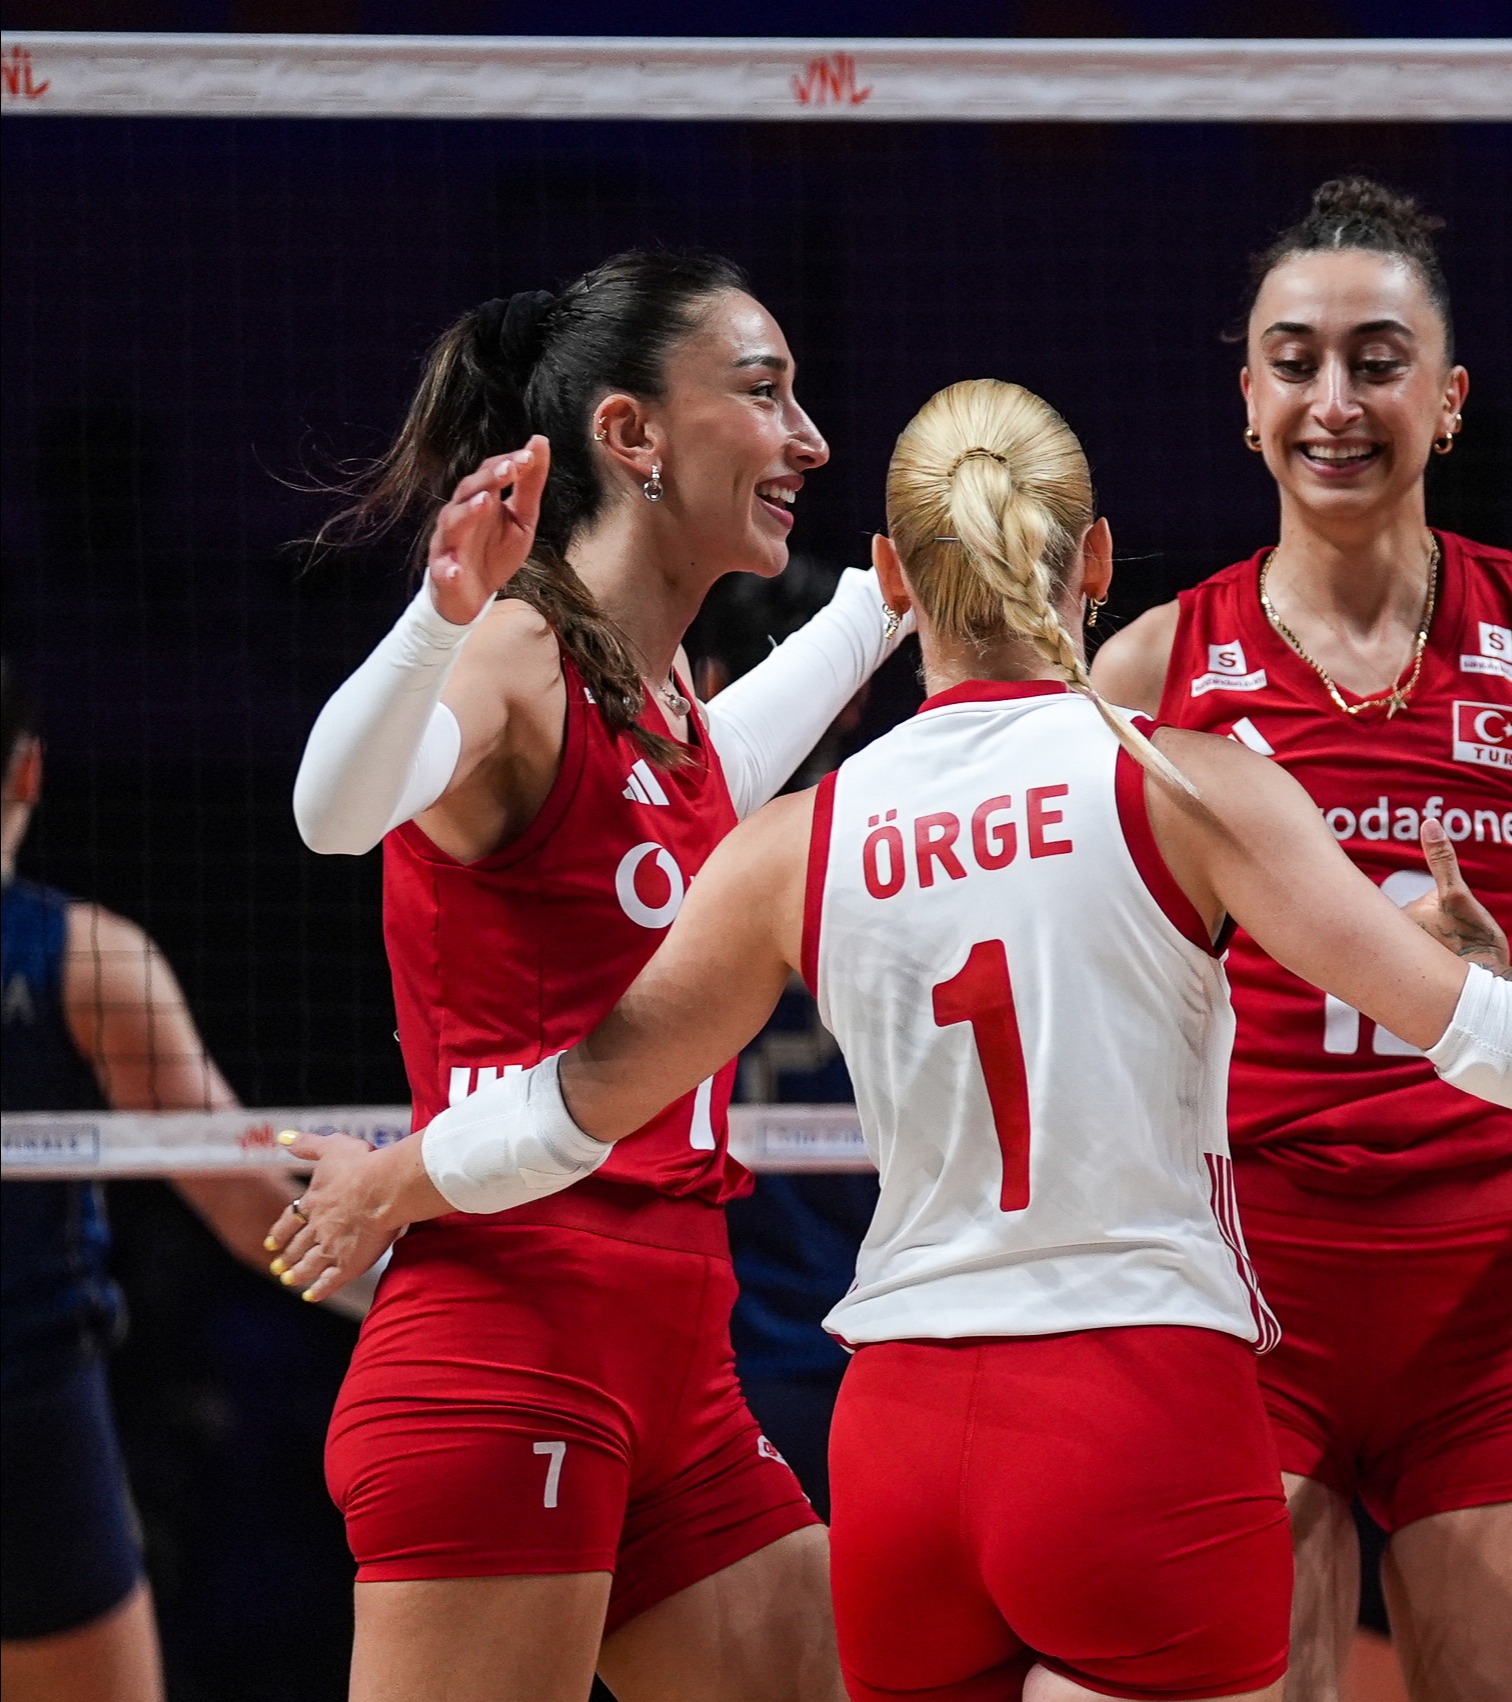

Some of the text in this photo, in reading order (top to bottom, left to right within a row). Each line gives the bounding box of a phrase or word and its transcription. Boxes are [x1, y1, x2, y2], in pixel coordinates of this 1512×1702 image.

[1, 45, 51, 99] NL
[792, 50, 873, 105] VNL
[1218, 652, 1236, 667] S
[1489, 633, 1504, 650] S
[862, 783, 1073, 899] ÖRGE
[932, 938, 1031, 1213] 1
[533, 1441, 566, 1508] 7
